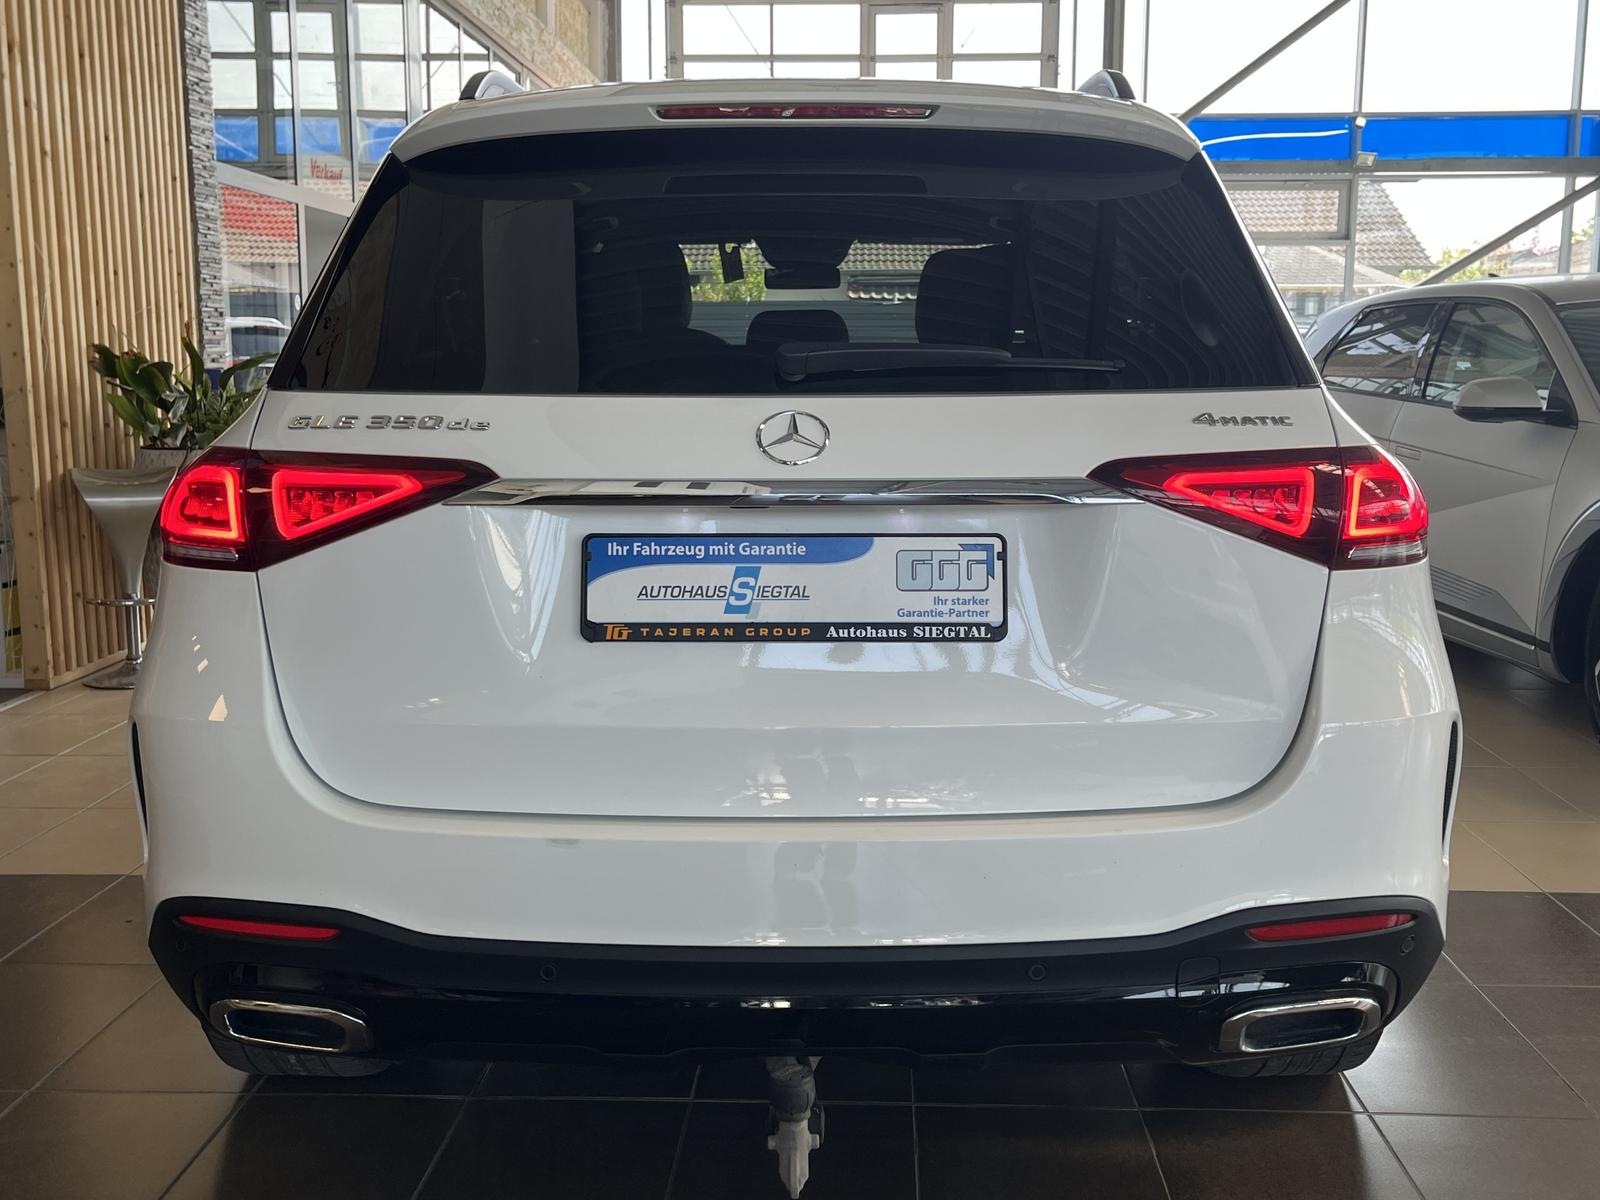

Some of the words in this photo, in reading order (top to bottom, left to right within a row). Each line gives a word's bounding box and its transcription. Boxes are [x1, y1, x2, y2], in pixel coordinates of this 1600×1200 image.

[310, 159, 344, 184] Verkauf
[288, 415, 360, 430] GLE
[1192, 412, 1294, 427] 4MATIC
[607, 542, 629, 556] Ihr
[633, 542, 705, 559] Fahrzeug
[709, 542, 736, 556] mit
[739, 542, 807, 556] Garantie
[933, 596, 949, 606] Ihr
[952, 596, 990, 606] starker
[896, 607, 990, 618] Garantie-Partner
[640, 627, 734, 637] TAJERAN
[745, 627, 811, 637] GROUP
[826, 625, 908, 638] Autohaus
[913, 625, 992, 638] SIEGTAL
